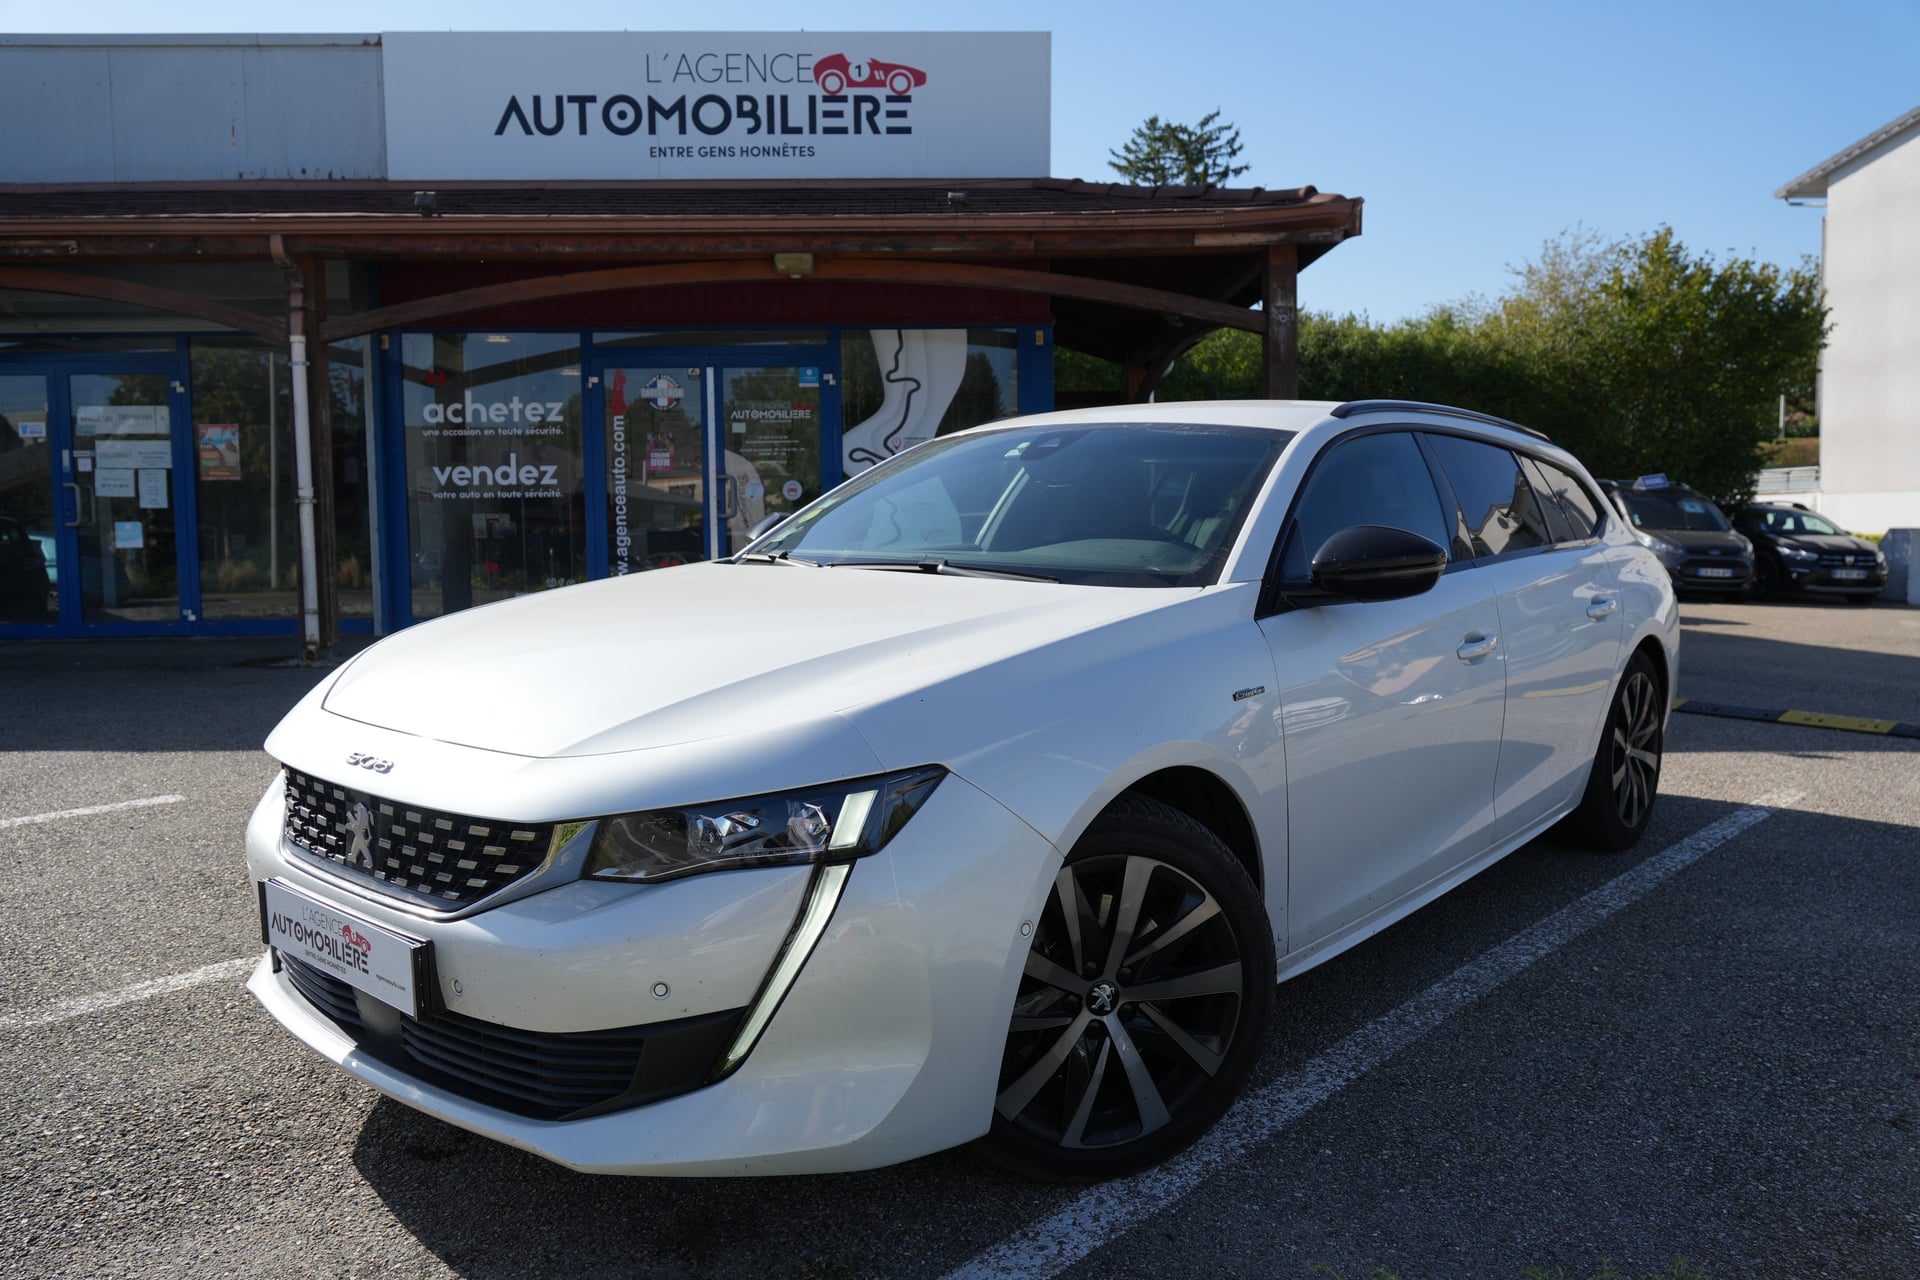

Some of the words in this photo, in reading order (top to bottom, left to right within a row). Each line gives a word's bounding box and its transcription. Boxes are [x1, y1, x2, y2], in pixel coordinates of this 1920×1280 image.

[646, 53, 814, 83] L'AGENCE
[855, 64, 862, 77] 1
[494, 94, 912, 136] AUTOMOBILIERE
[649, 146, 694, 158] ENTRE
[698, 146, 735, 158] GENS
[740, 142, 815, 158] HONNÊTES
[422, 390, 564, 424] achetez
[422, 429, 440, 437] une
[442, 427, 481, 436] occasion
[498, 427, 522, 436] toute
[525, 426, 564, 436] sécurité.
[432, 452, 558, 486] vendez
[432, 491, 457, 499] votre
[459, 491, 481, 499] auto
[497, 490, 521, 498] toute
[524, 489, 564, 498] sérénité.
[345, 752, 395, 774] 508
[301, 905, 343, 937] L'AGENCE
[271, 911, 370, 975] AUTOMOBILIERE
